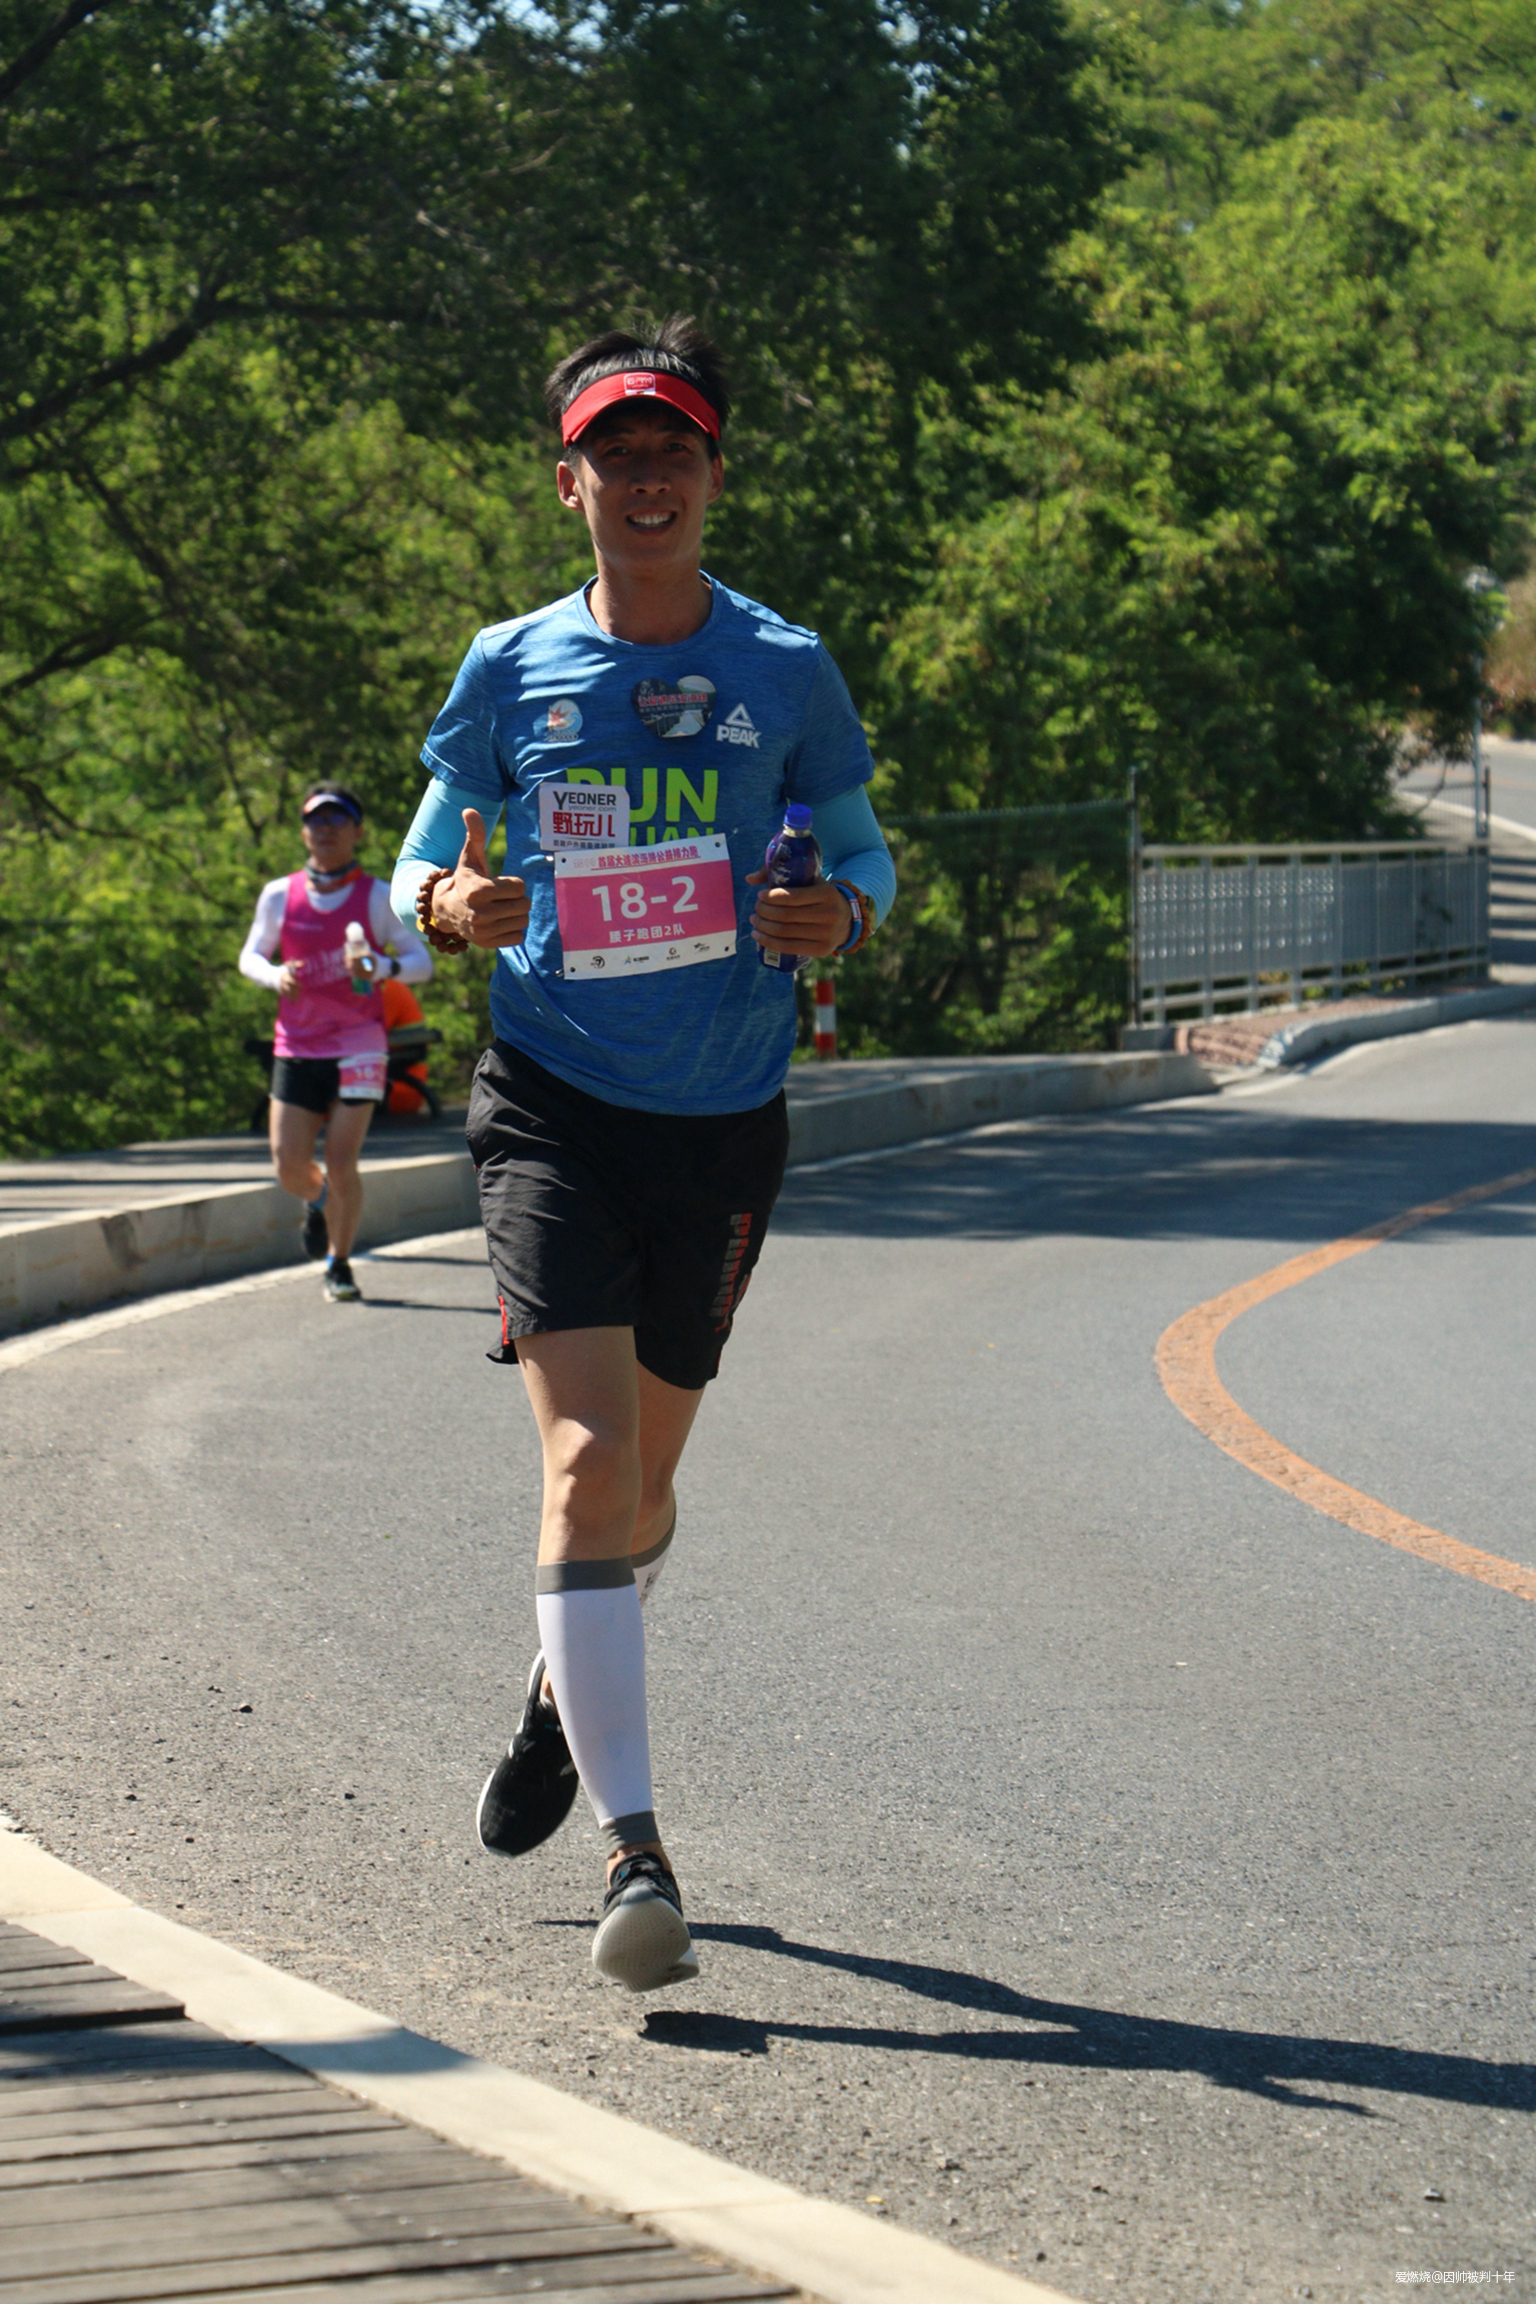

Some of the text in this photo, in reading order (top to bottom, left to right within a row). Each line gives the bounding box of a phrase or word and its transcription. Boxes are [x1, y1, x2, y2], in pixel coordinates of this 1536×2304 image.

[716, 724, 762, 749] PEAK
[553, 790, 617, 810] YEONER
[568, 804, 617, 812] yeoner.com
[552, 811, 616, 838] 野玩儿
[592, 875, 699, 922] 18-2
